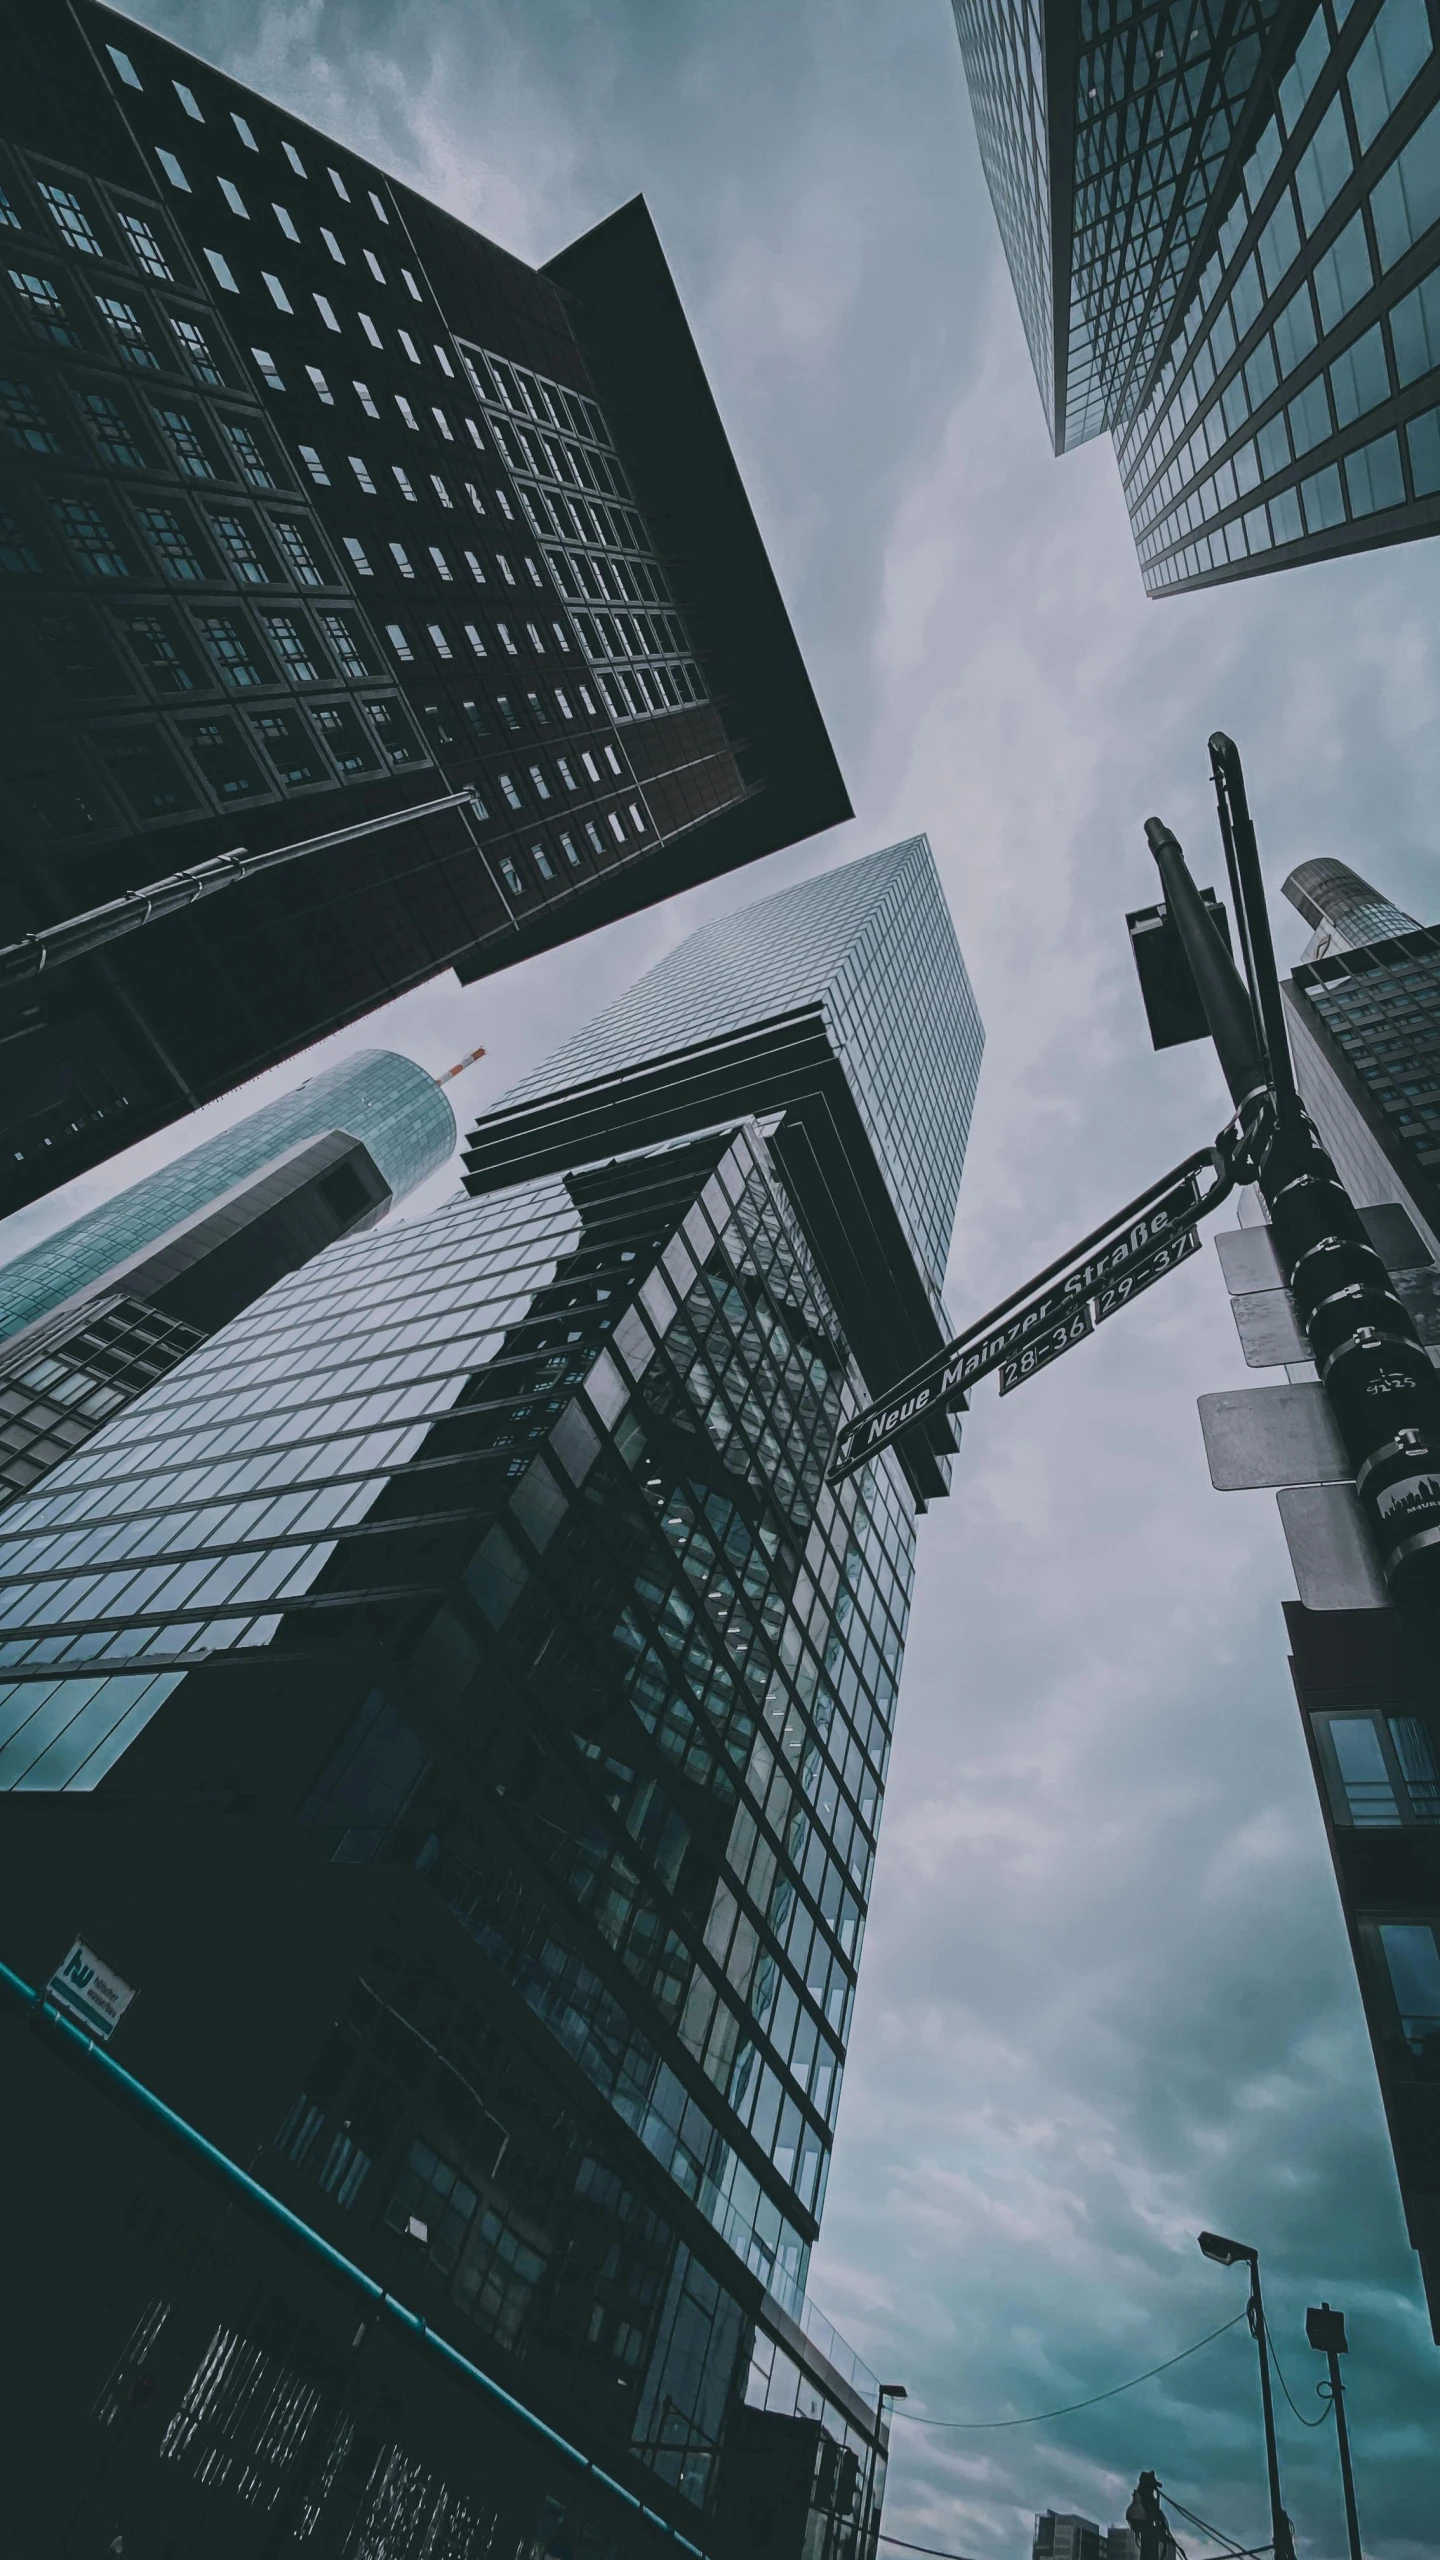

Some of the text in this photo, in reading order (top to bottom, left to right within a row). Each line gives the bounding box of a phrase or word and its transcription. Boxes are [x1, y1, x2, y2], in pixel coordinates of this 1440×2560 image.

[1100, 1234, 1187, 1313] 29-37
[867, 1210, 1170, 1445] Neue Mainzer Straße
[1004, 1314, 1085, 1388] 28-36
